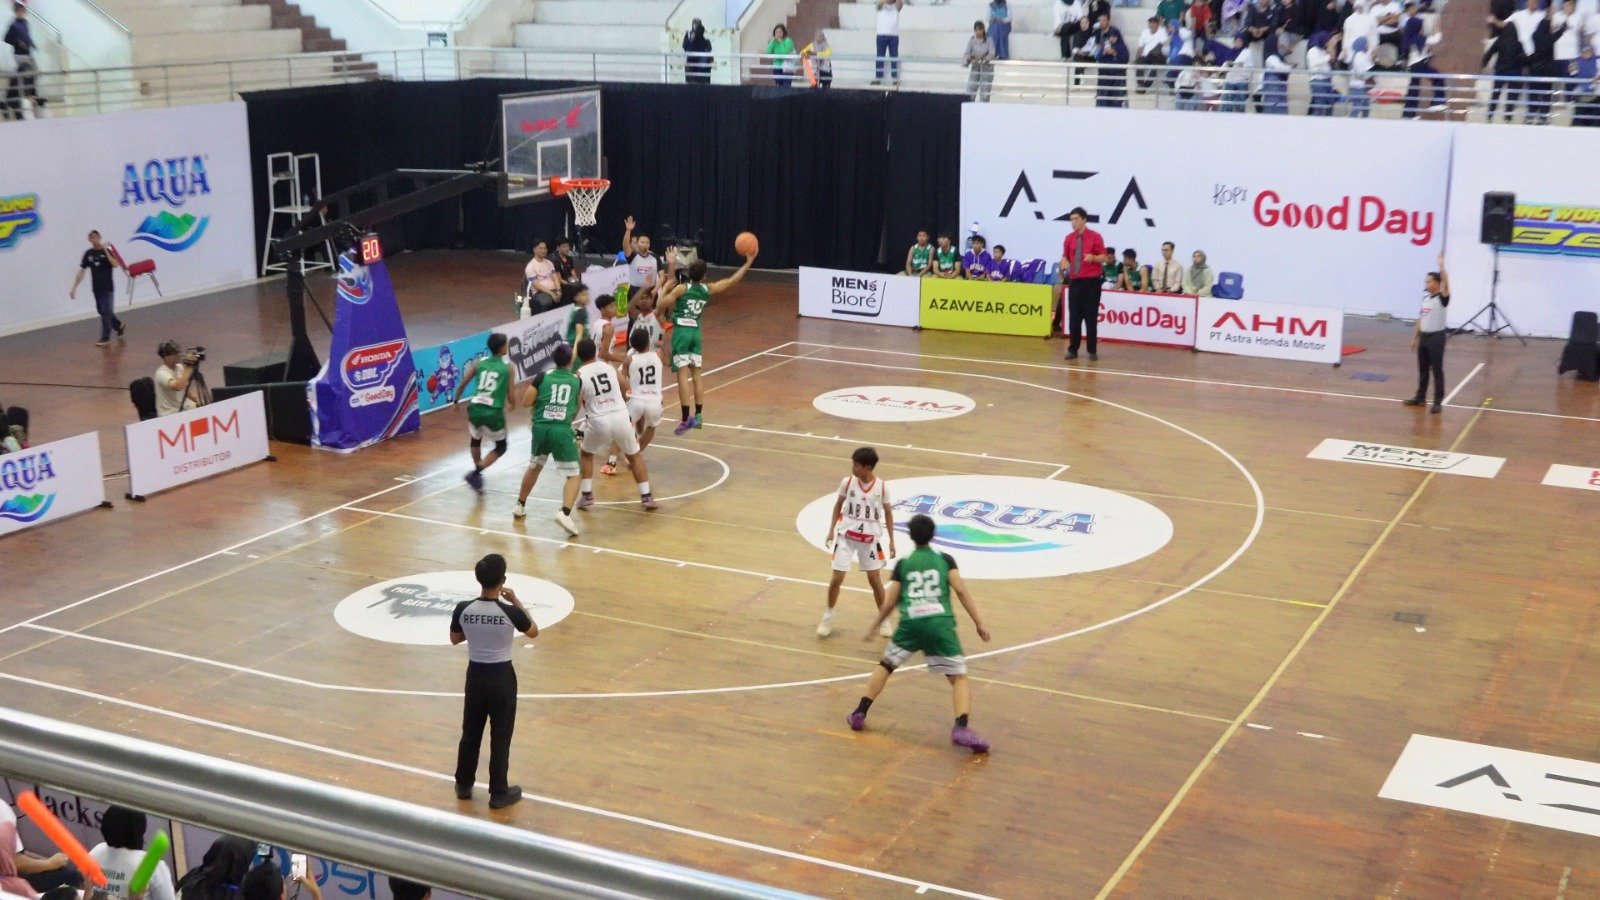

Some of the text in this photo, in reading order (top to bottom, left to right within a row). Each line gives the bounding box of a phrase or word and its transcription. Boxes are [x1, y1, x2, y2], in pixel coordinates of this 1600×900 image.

[120, 155, 210, 206] AQUA
[999, 169, 1157, 227] AZA
[1254, 190, 1350, 231] Good
[1358, 196, 1436, 246] Day
[362, 239, 380, 261] 20
[832, 289, 876, 307] Bioré
[929, 299, 1043, 316] AZAWEAR.COM
[1146, 306, 1186, 335] Day
[1212, 312, 1327, 338] AHM
[1209, 331, 1326, 351] PT Astra Honda Motor
[361, 352, 392, 363] HONDA
[478, 370, 500, 391] 16
[590, 373, 611, 396] 15
[638, 365, 656, 385] 12
[550, 384, 571, 405] 10
[158, 409, 240, 459] MPM
[0, 452, 55, 491] QUA
[173, 450, 231, 475] DISTRIBUTOR
[891, 491, 1096, 534] AQUA
[858, 523, 864, 533] 4
[869, 550, 875, 560] 4
[906, 568, 942, 598] 22
[463, 613, 505, 626] REFEREE
